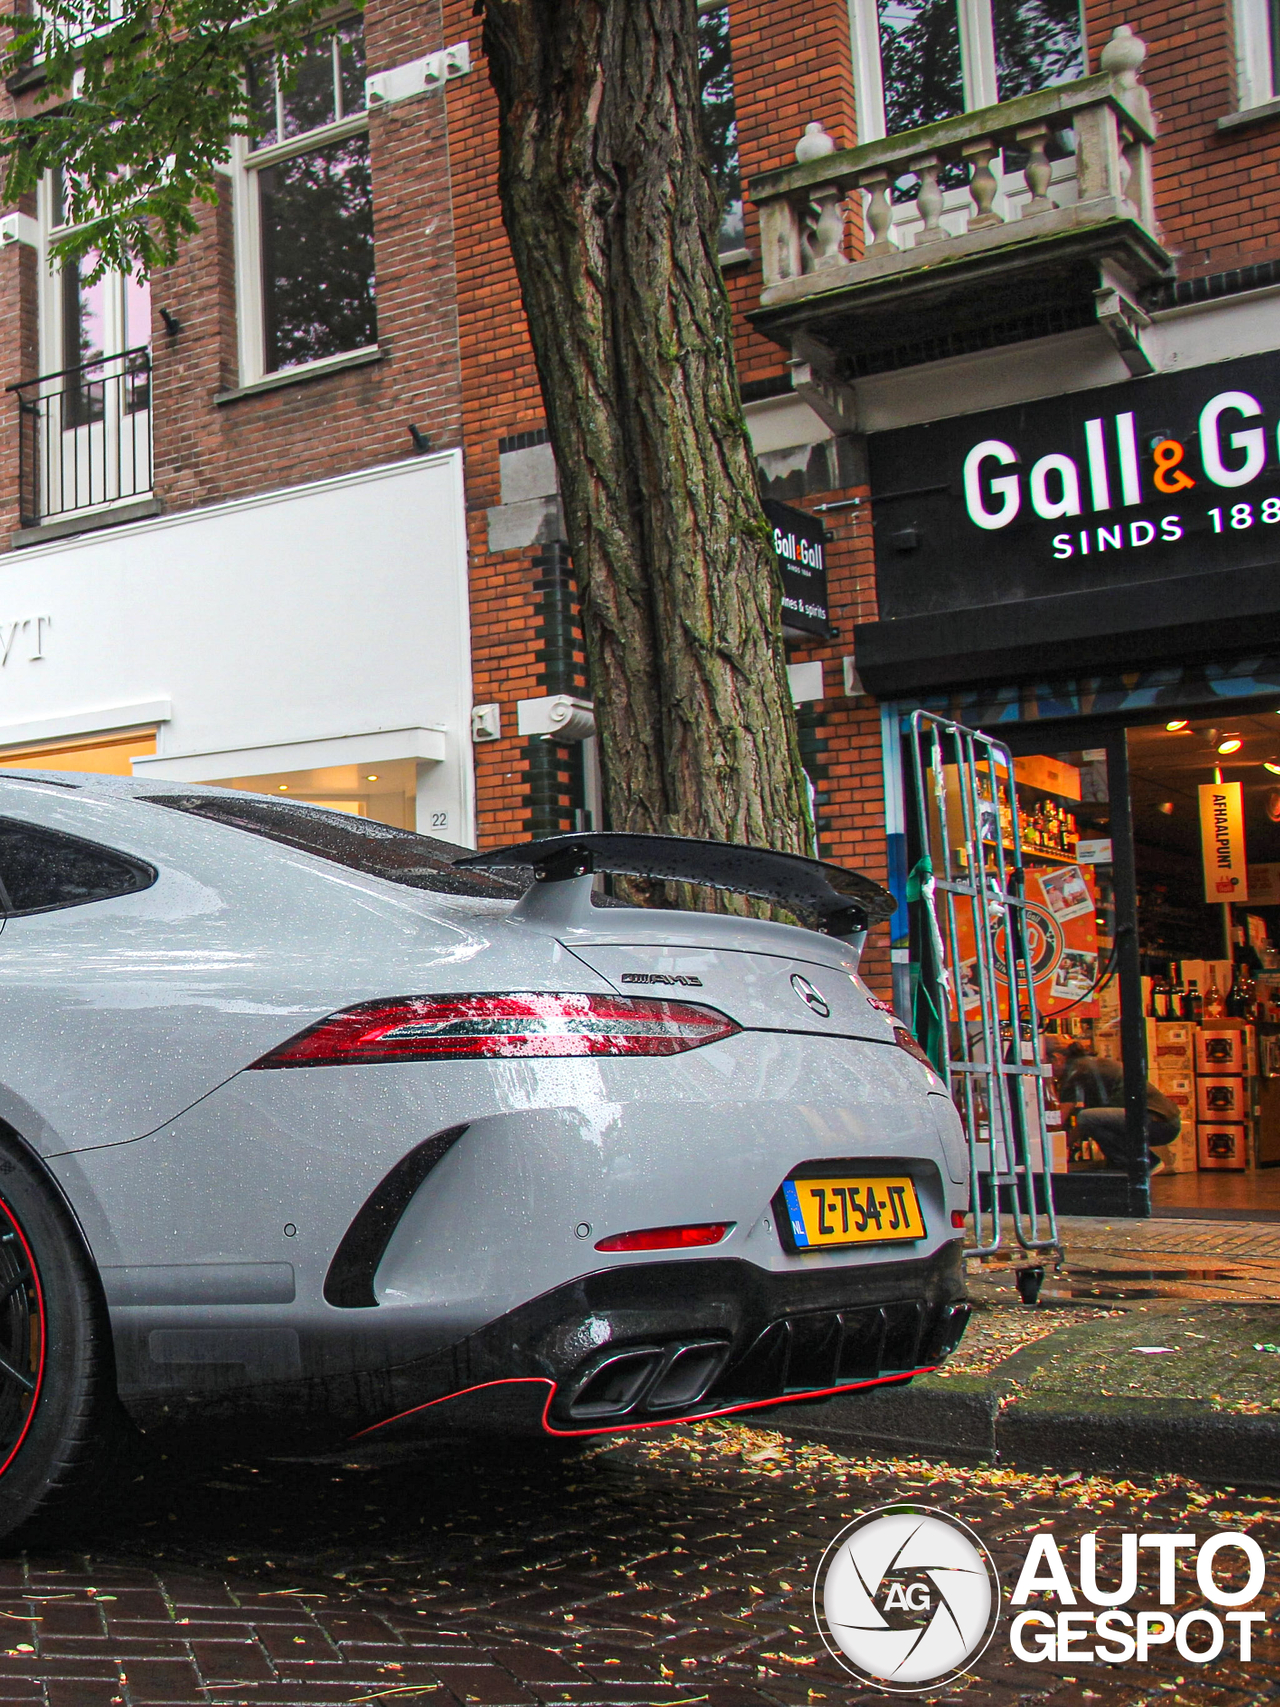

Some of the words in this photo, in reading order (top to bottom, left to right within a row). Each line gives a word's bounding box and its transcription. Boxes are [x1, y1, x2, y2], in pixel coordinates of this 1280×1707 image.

[1052, 516, 1184, 559] SINDS
[798, 599, 804, 613] &
[805, 603, 826, 620] spirits
[432, 813, 447, 827] 22
[1213, 794, 1232, 869] AFHAALPUNT
[810, 1186, 910, 1235] Z-754-JT
[792, 1221, 805, 1234] NL
